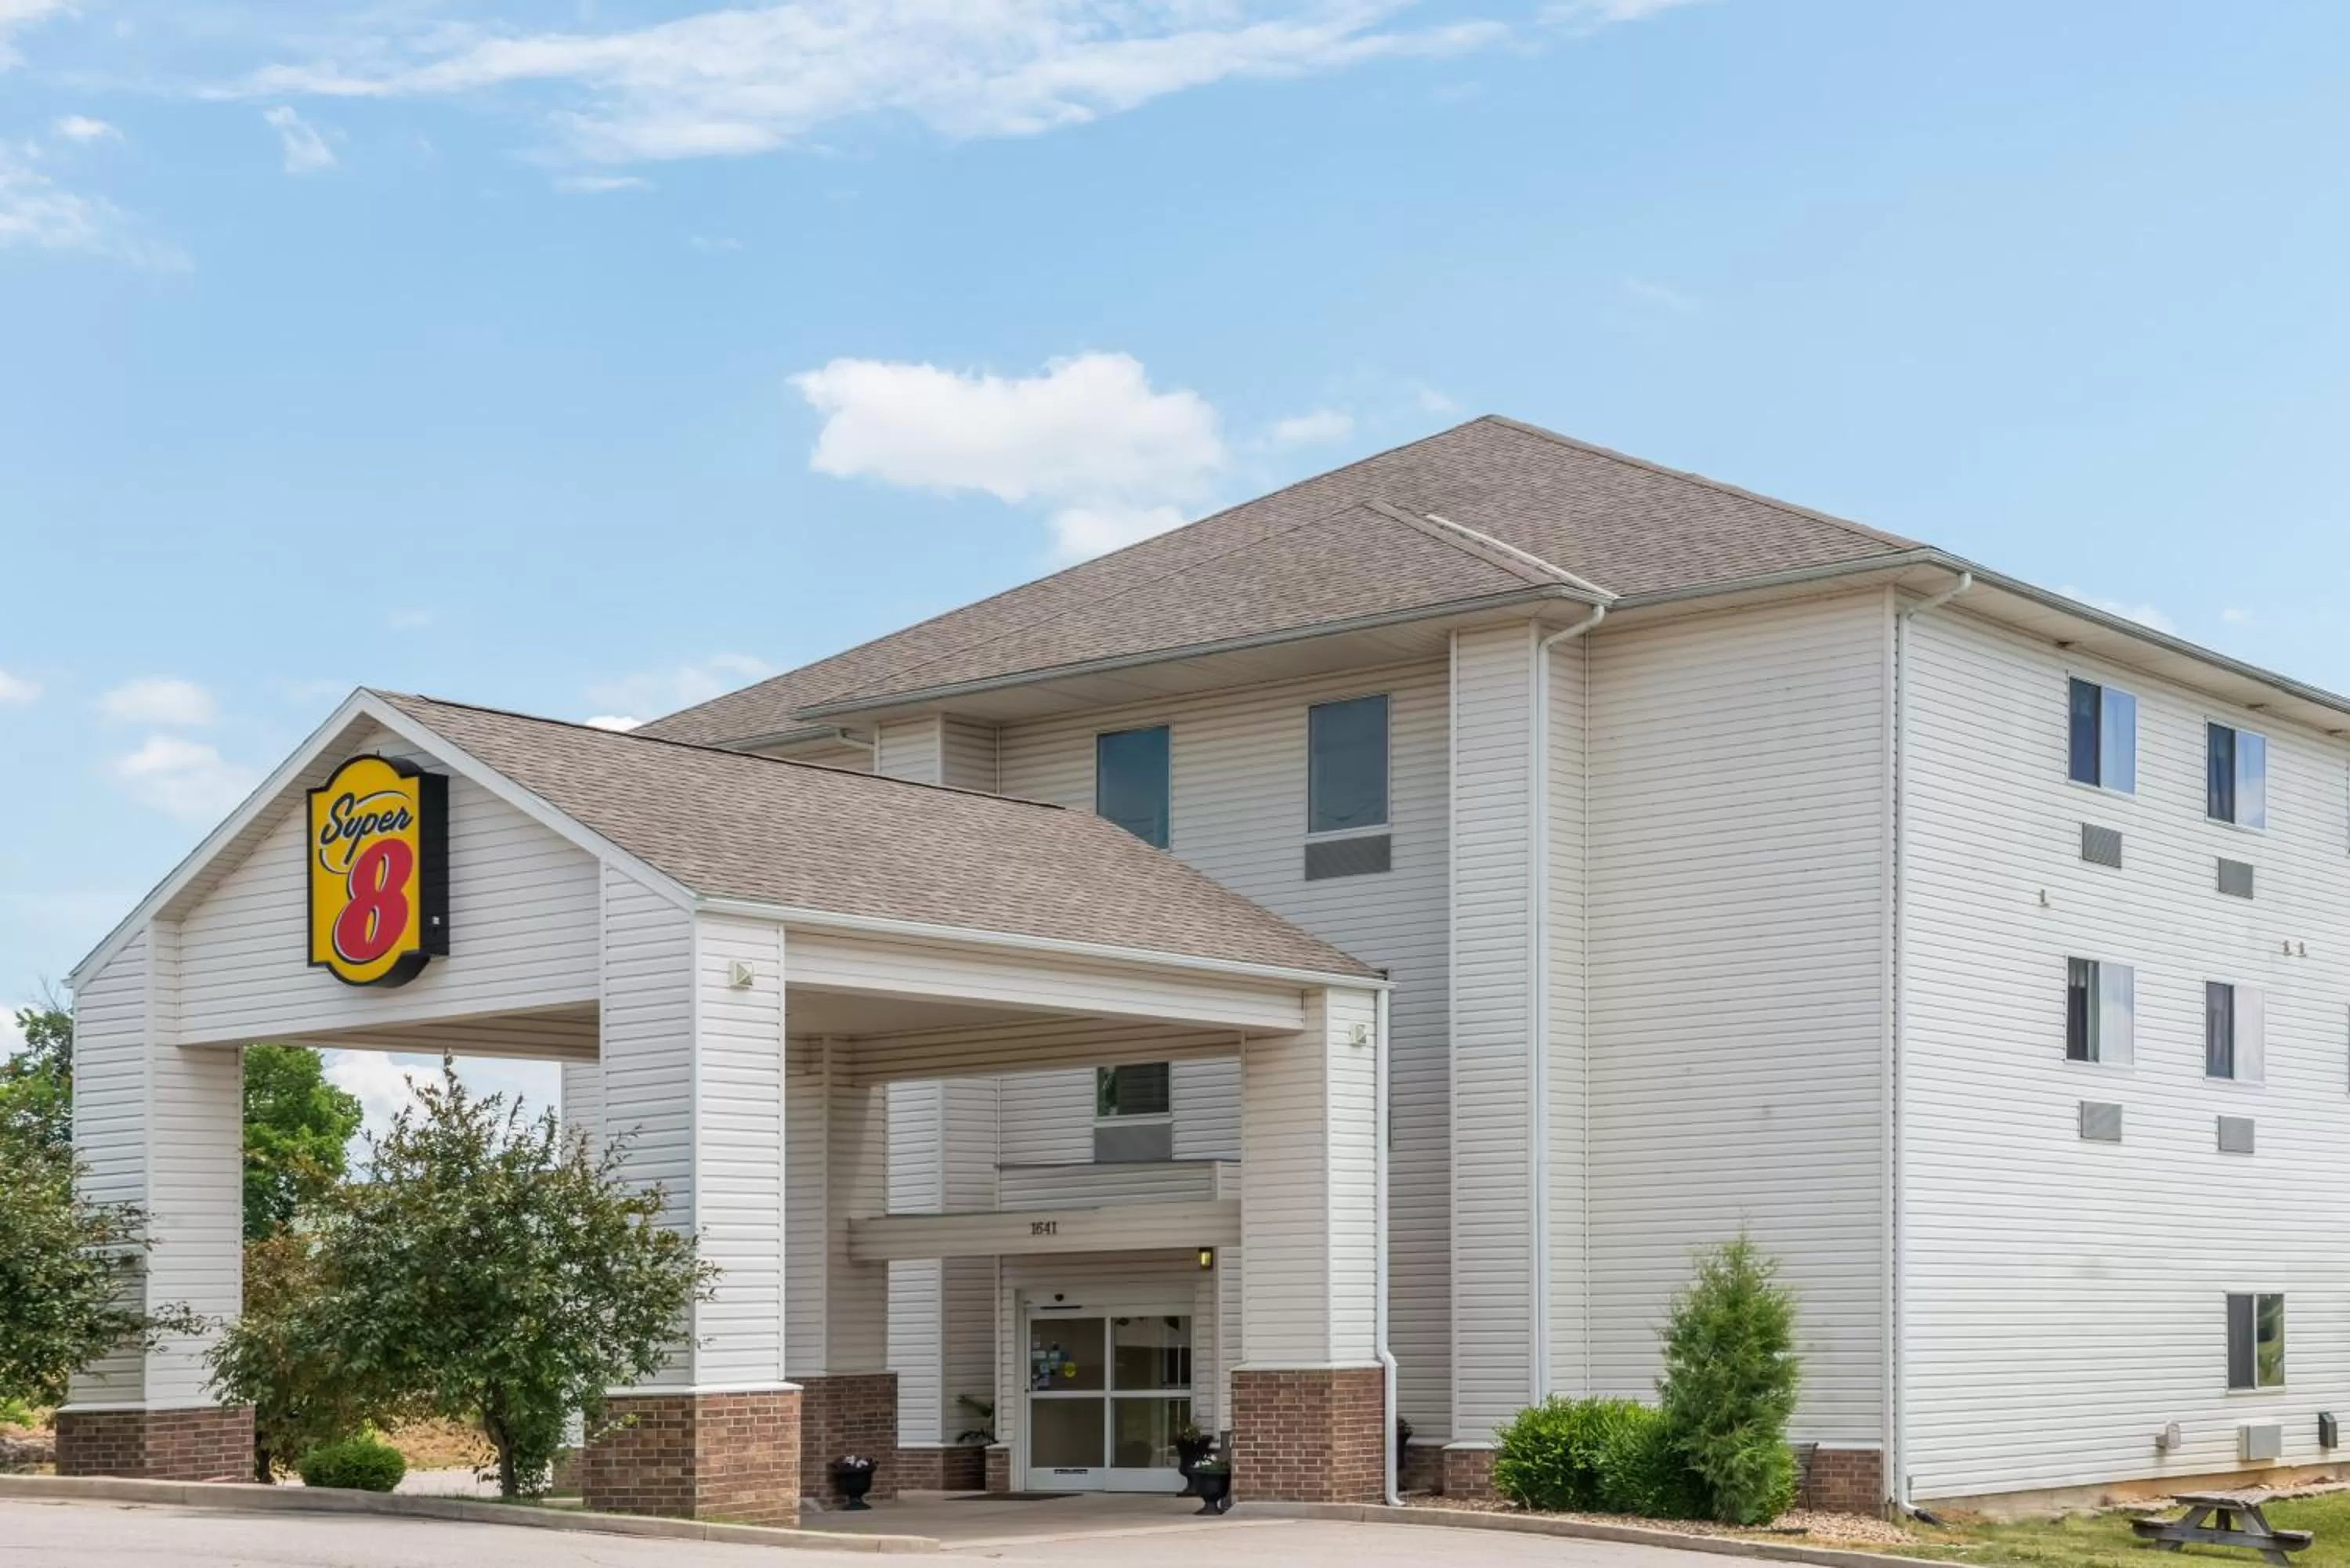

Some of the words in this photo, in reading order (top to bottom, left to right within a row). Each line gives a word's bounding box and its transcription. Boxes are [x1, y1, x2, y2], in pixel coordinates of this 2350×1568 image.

[319, 791, 414, 865] Super
[331, 837, 414, 966] 8
[1030, 1221, 1057, 1235] 1641
